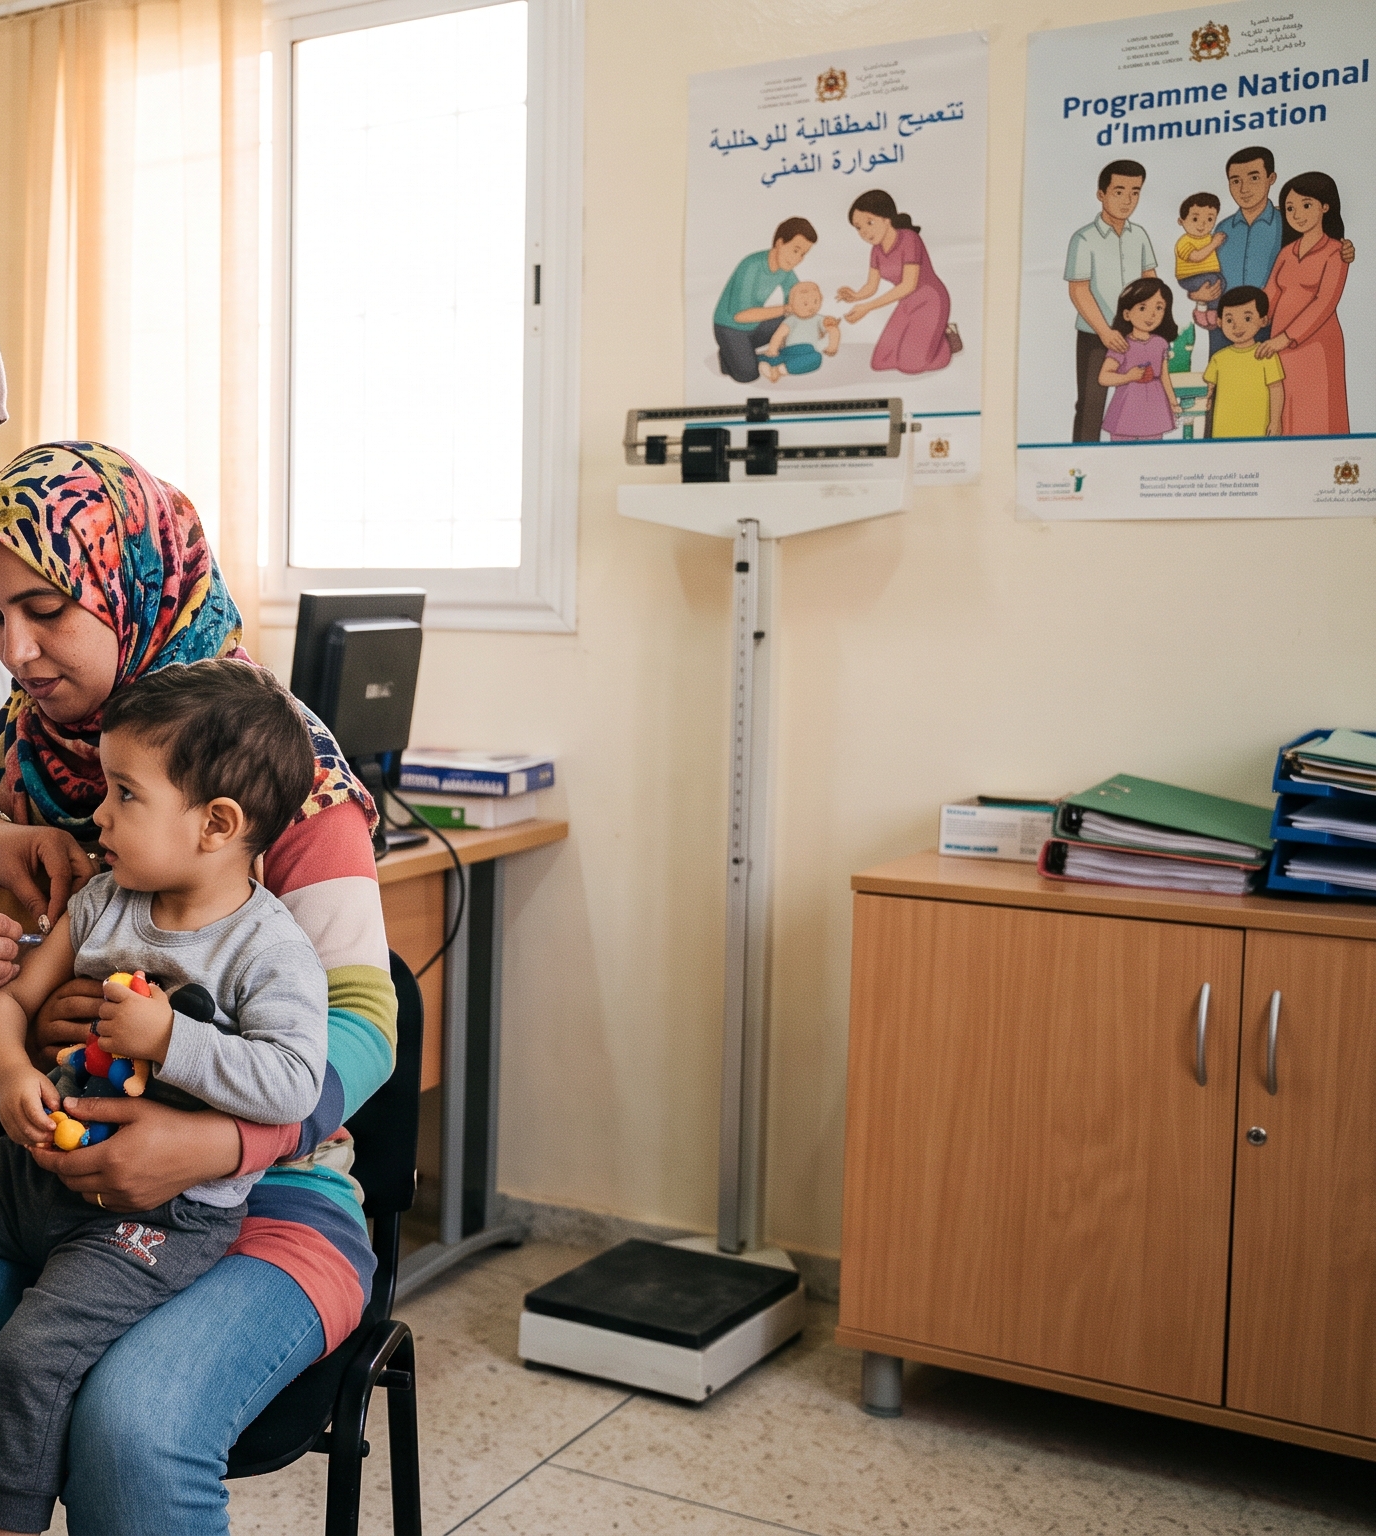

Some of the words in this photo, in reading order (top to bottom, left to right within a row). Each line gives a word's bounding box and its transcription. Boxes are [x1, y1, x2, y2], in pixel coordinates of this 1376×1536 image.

[1063, 82, 1228, 119] Programme
[1237, 58, 1370, 98] National
[1096, 103, 1327, 147] d'Immunisation
